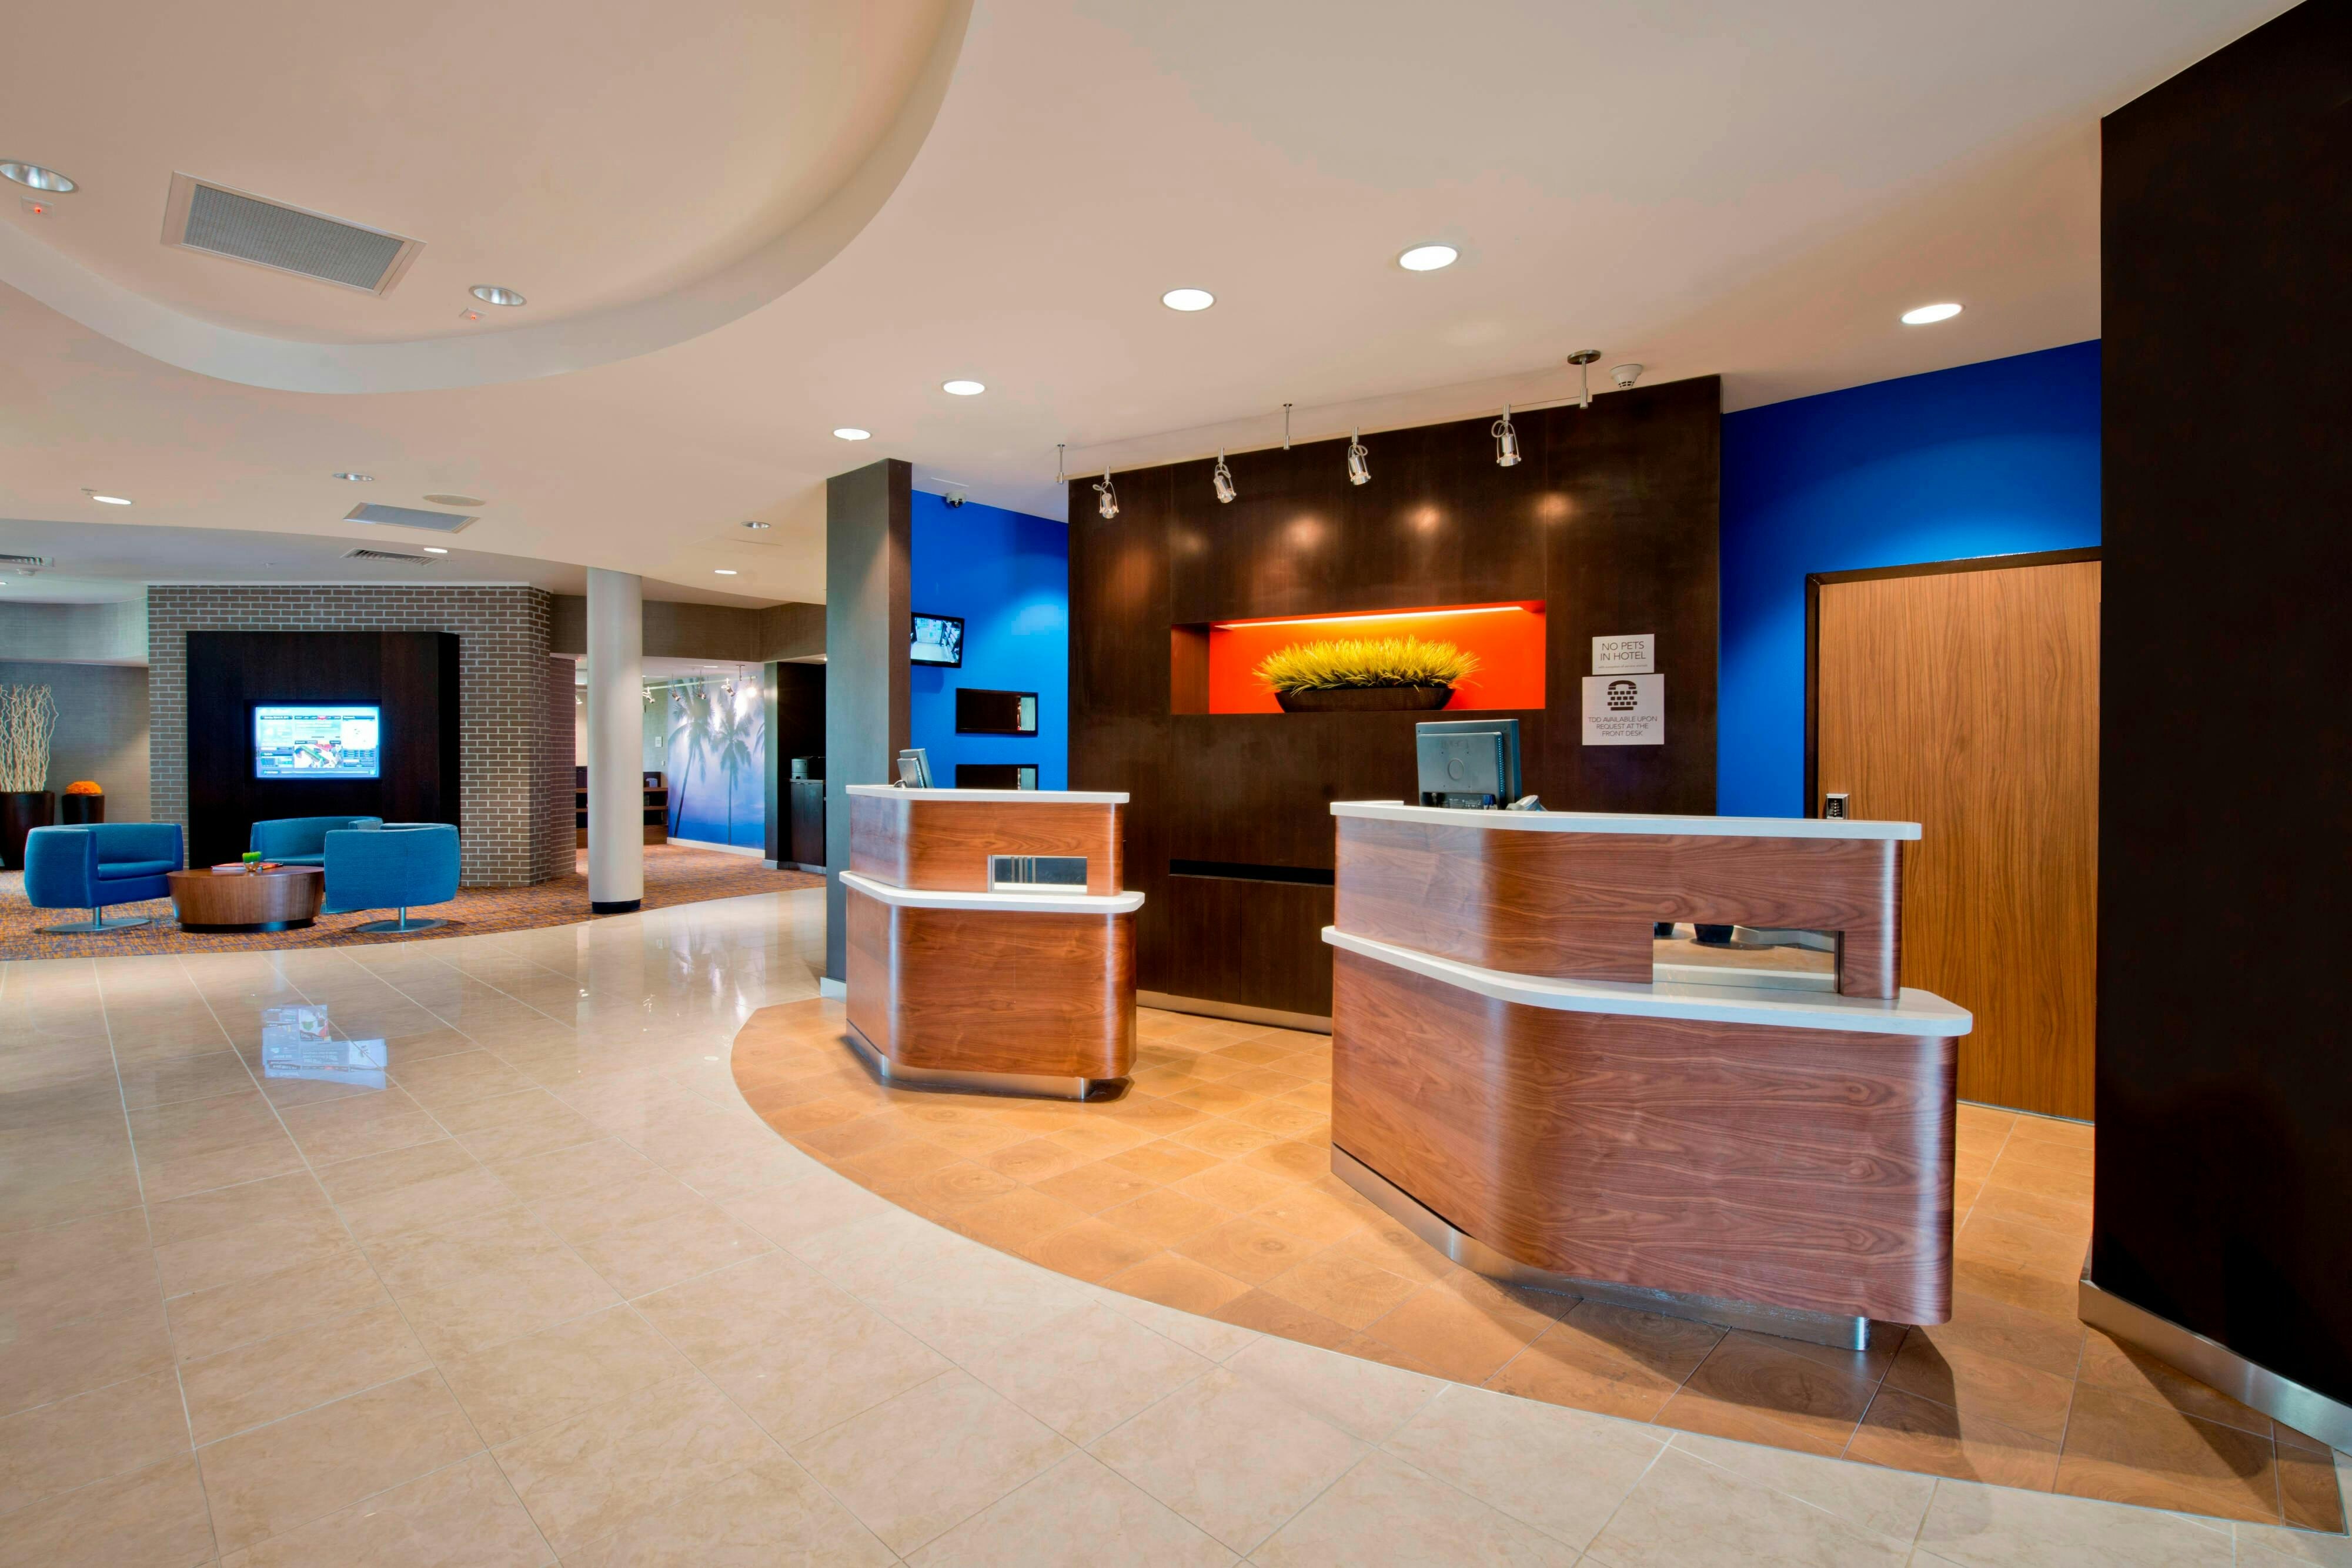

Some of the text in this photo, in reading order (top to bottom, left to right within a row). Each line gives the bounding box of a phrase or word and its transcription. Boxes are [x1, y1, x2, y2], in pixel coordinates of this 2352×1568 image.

[1602, 641, 1645, 651] NO PETS
[1600, 651, 1646, 661] IN HOTEL
